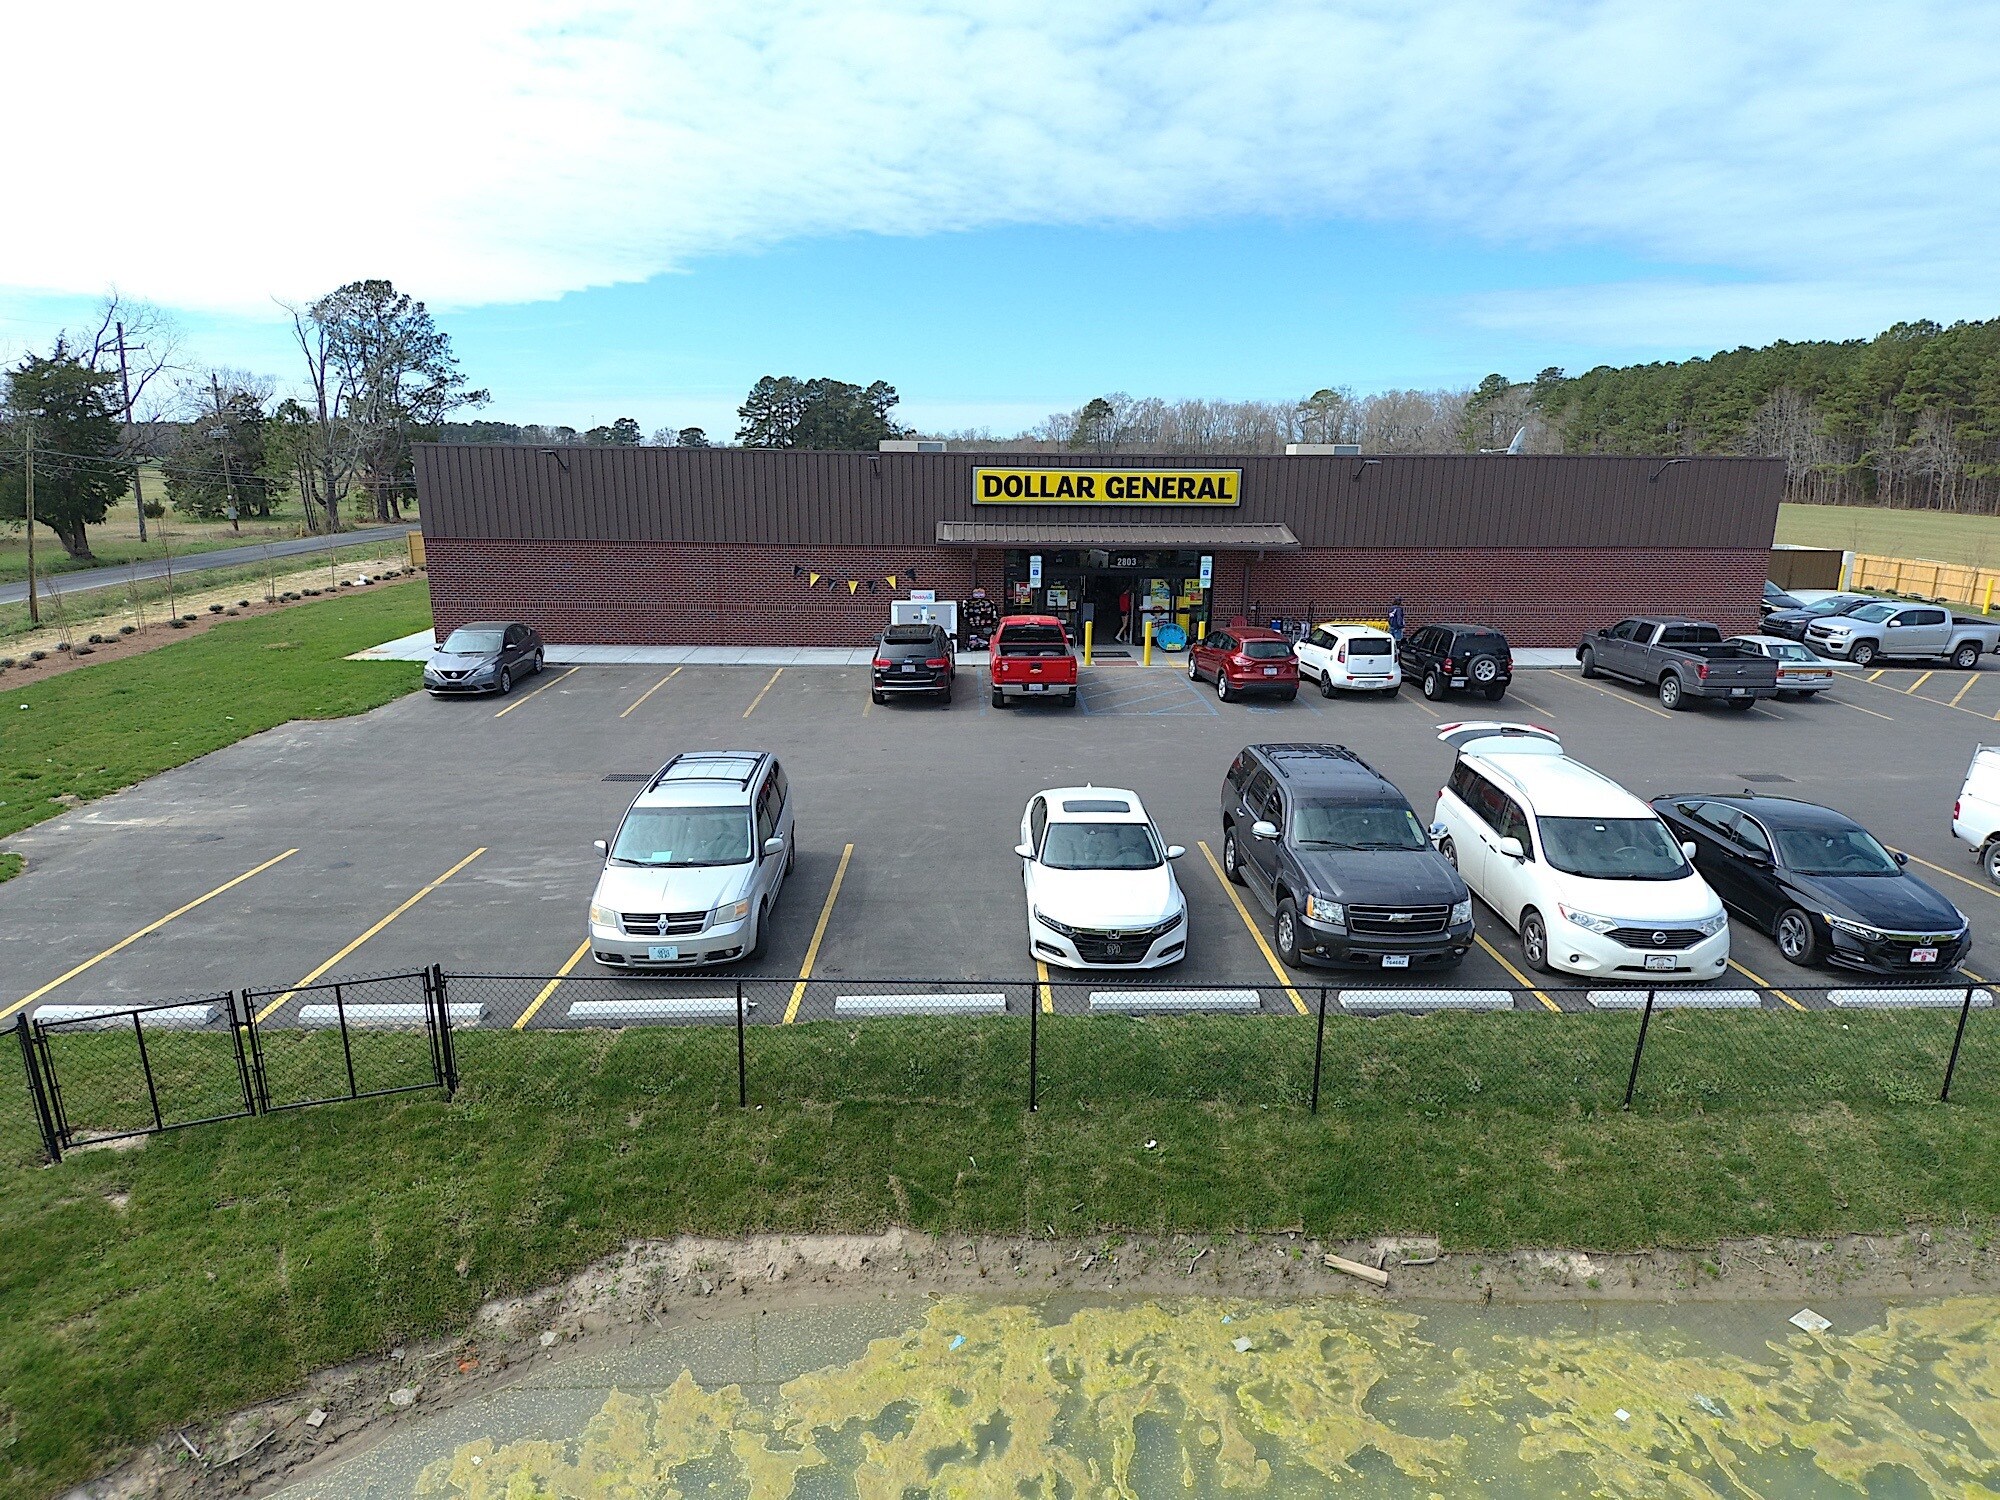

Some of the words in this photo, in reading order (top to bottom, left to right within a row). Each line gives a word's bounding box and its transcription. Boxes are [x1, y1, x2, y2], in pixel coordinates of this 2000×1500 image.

[982, 475, 1096, 498] DOLLAR
[1105, 477, 1233, 499] GENERAL
[1117, 557, 1137, 566] 2803
